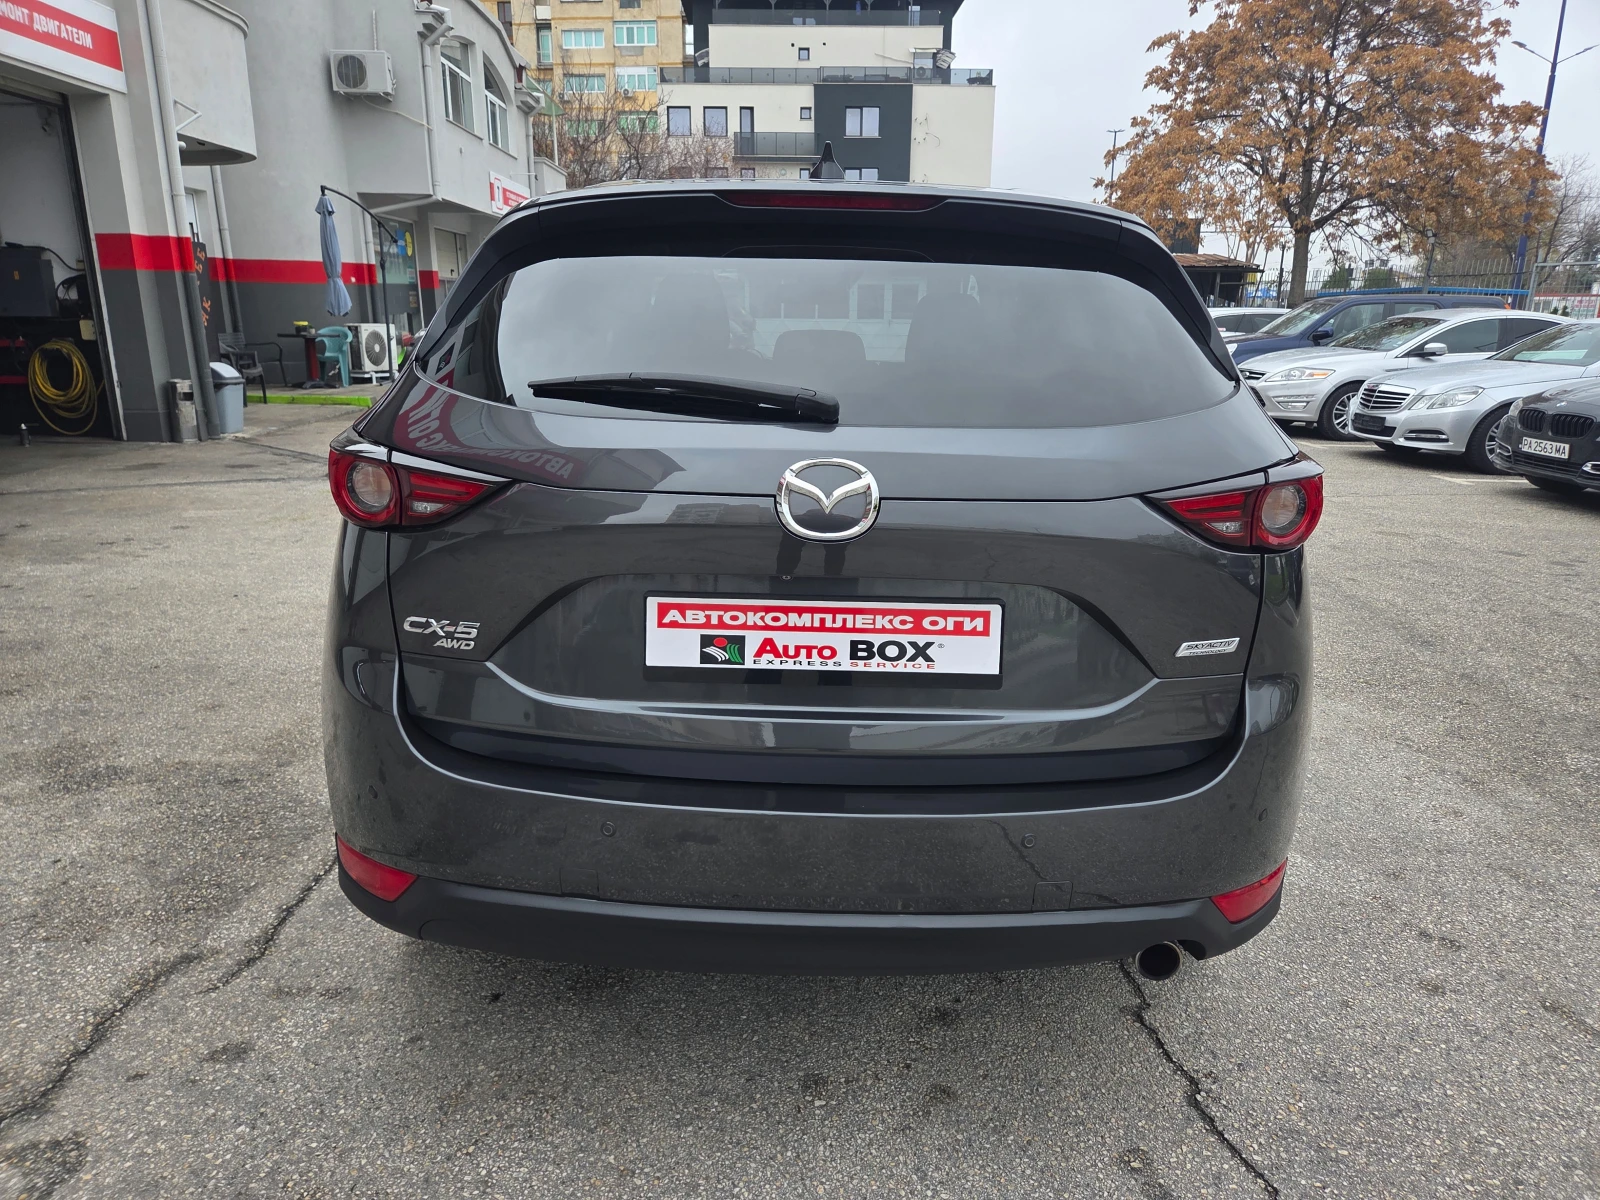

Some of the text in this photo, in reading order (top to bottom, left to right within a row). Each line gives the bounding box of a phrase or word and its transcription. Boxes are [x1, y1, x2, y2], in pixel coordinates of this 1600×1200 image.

[33, 12, 93, 49] ДВИГАТЕЛИ
[1533, 441, 1553, 454] 2563
[662, 609, 984, 632] АВТОКОМПЛЕКС ОГИ
[403, 616, 480, 639] CX-5
[433, 638, 475, 650] AWD
[1187, 640, 1235, 650] SKYACTIV
[753, 659, 936, 670] EXPRESS SERVICE
